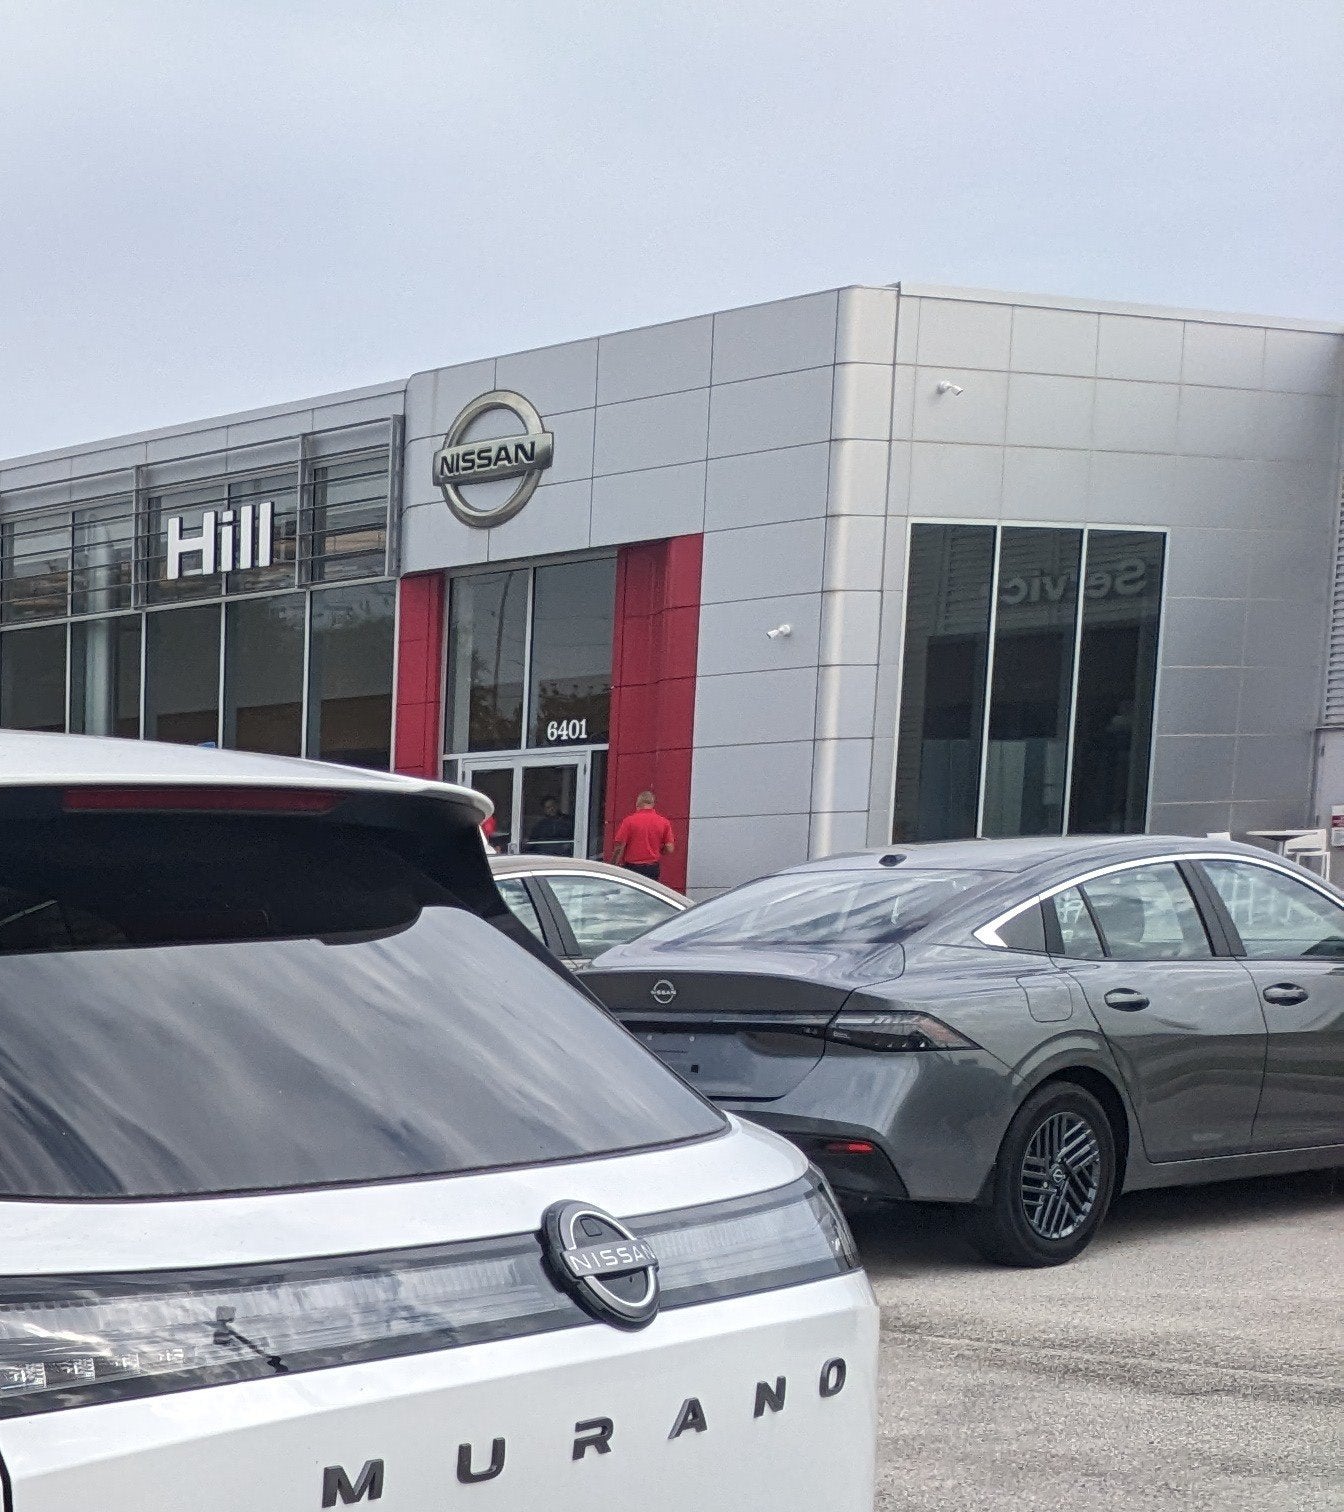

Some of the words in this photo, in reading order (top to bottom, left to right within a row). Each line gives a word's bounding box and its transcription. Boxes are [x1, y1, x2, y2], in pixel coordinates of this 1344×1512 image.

[439, 439, 536, 477] NISSAN
[166, 501, 274, 580] Hill
[547, 718, 588, 741] 6401
[568, 1243, 657, 1272] NISSAN
[321, 1356, 847, 1509] MURANO
